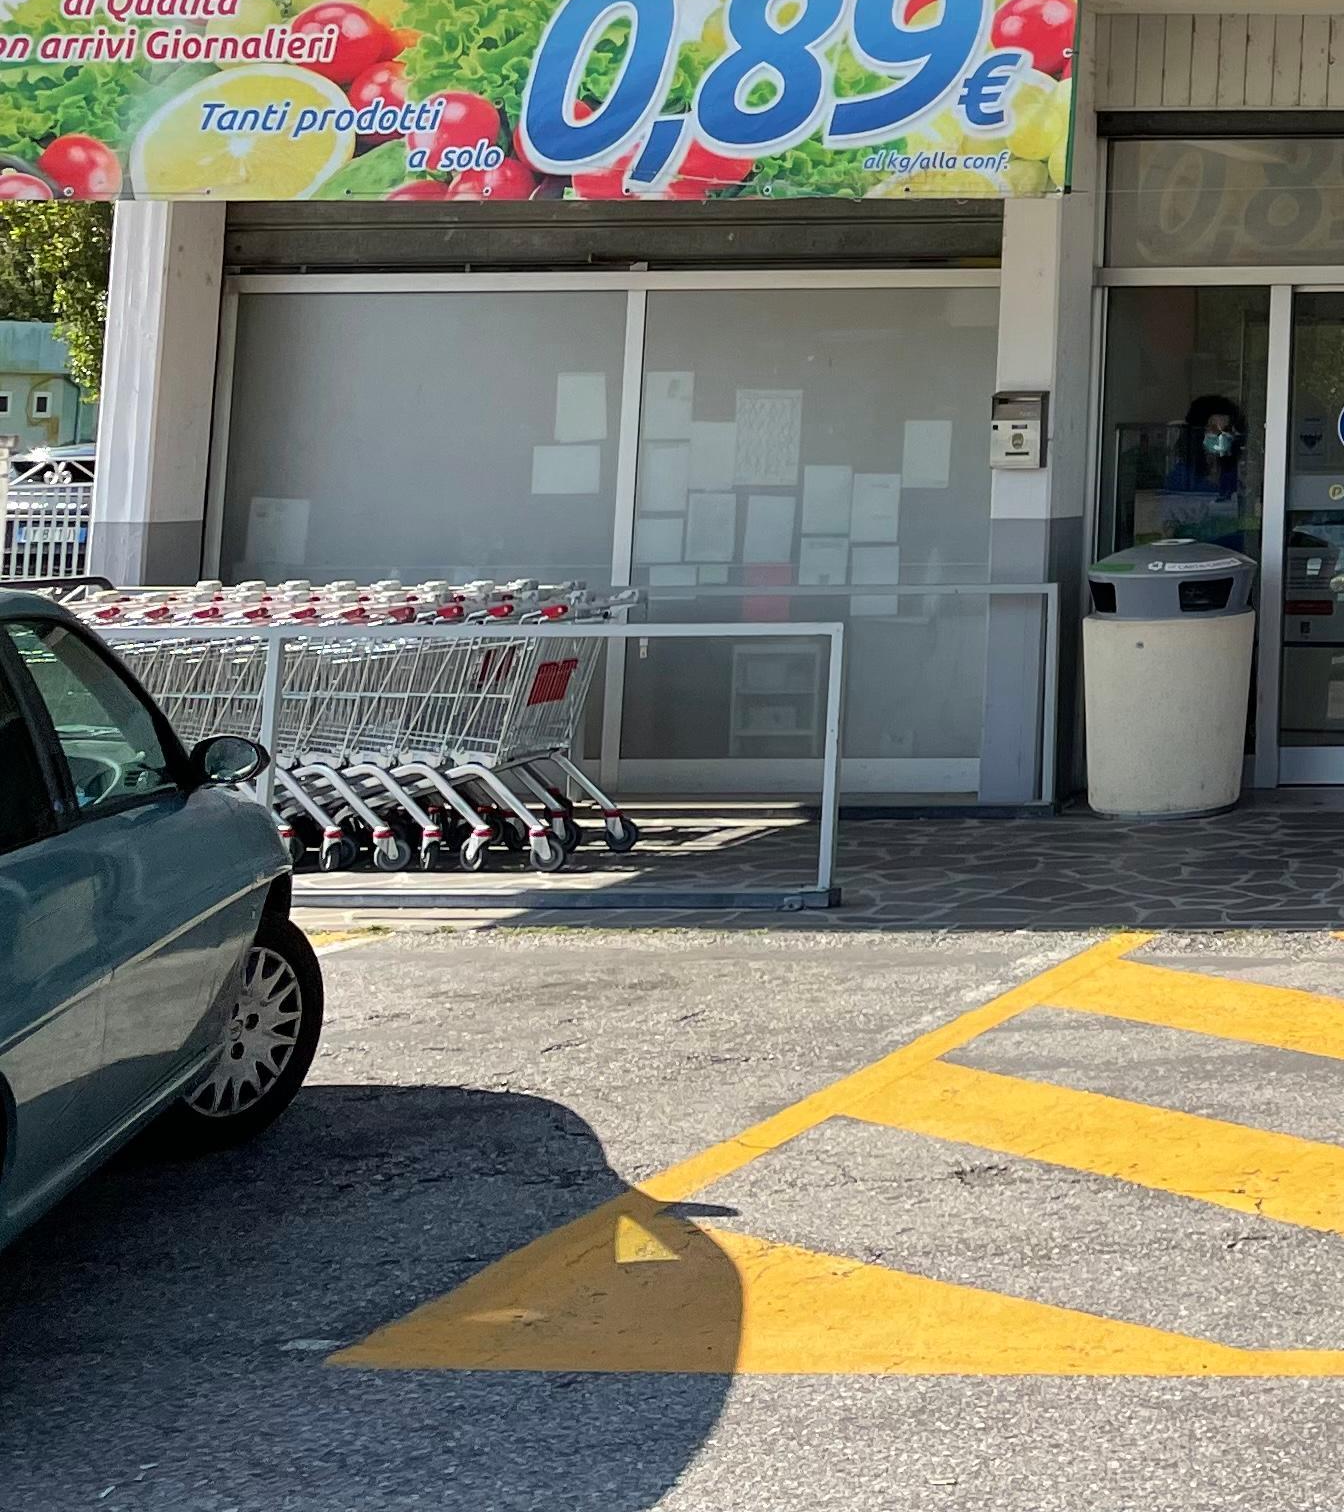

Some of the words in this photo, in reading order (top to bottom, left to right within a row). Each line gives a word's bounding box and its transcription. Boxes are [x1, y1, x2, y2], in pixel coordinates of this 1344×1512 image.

[40, 29, 134, 59] arrivi
[146, 29, 336, 59] Giornalieri
[201, 101, 291, 131] Tanti
[292, 100, 440, 138] prodotti
[409, 148, 426, 168] a
[441, 142, 502, 169] solo
[864, 152, 884, 169] al
[887, 151, 957, 173] kg/alla
[963, 151, 1009, 172] conf.
